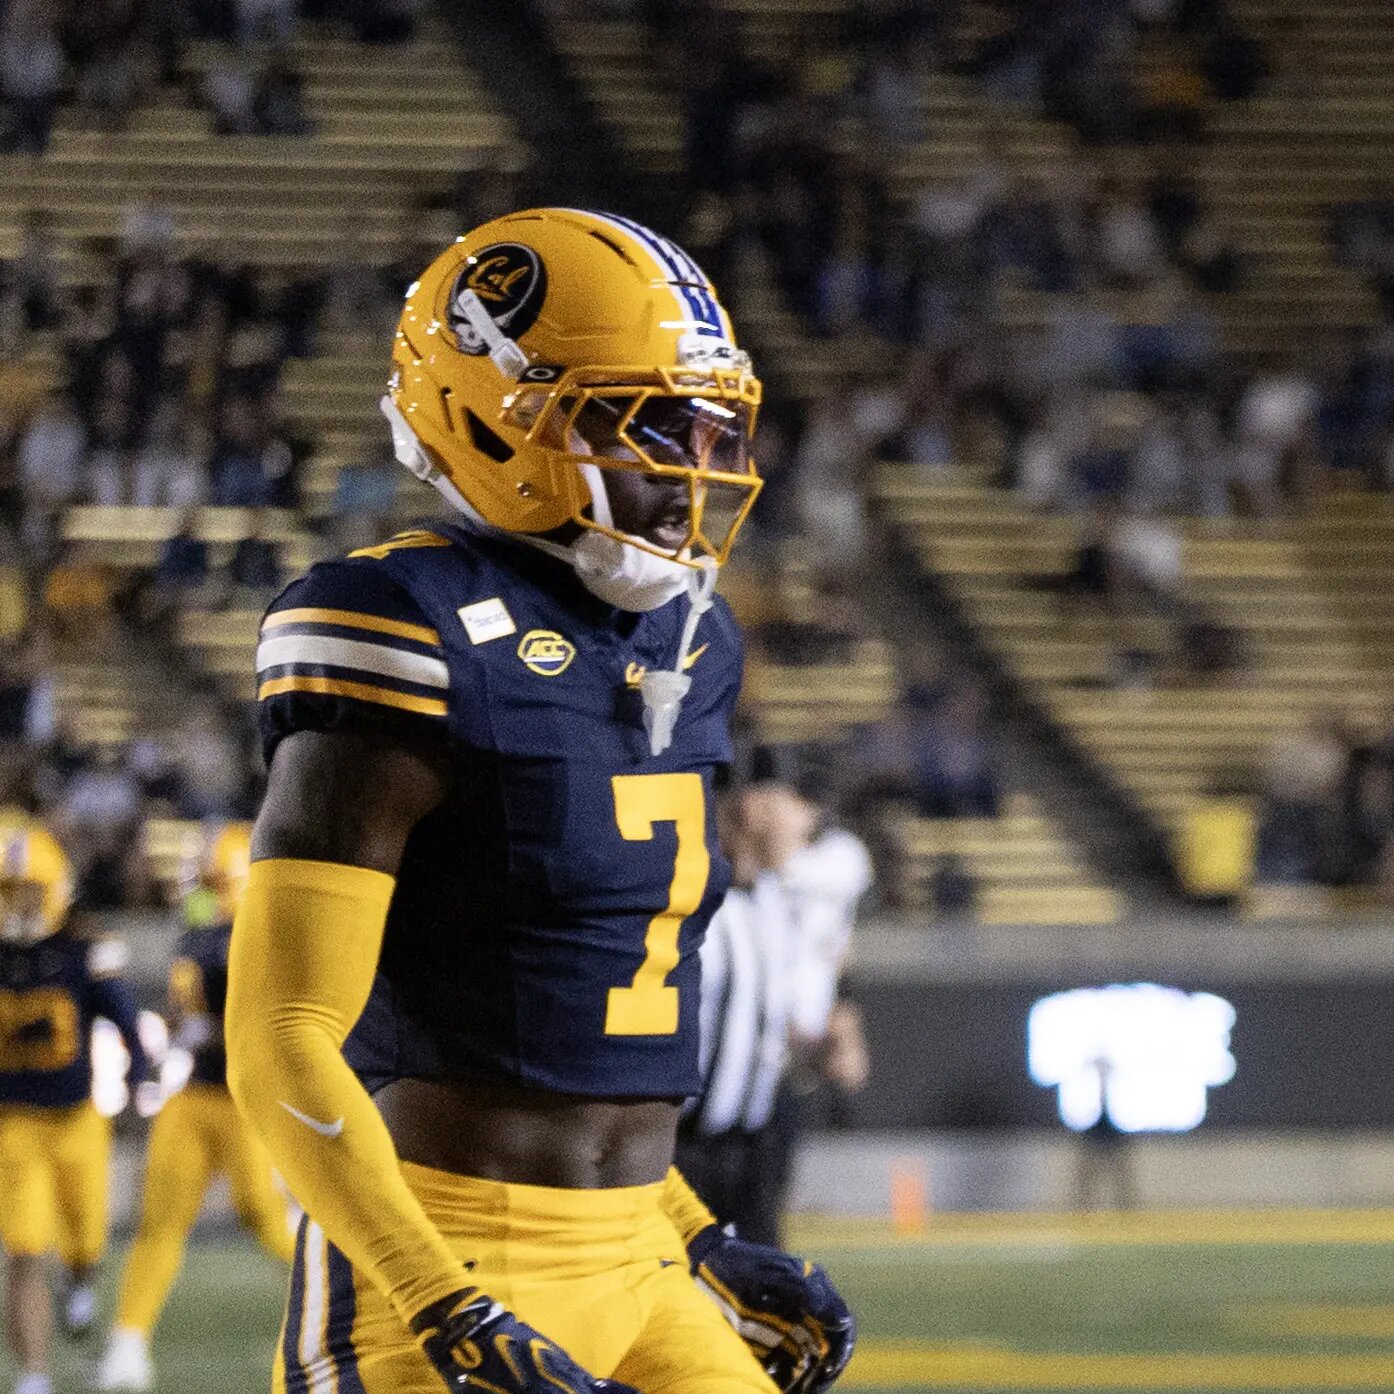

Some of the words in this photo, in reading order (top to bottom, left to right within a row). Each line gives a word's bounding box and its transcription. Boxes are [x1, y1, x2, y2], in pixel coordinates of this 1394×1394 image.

[467, 256, 530, 302] Cal
[526, 639, 570, 658] ACC
[603, 772, 711, 1036] 7
